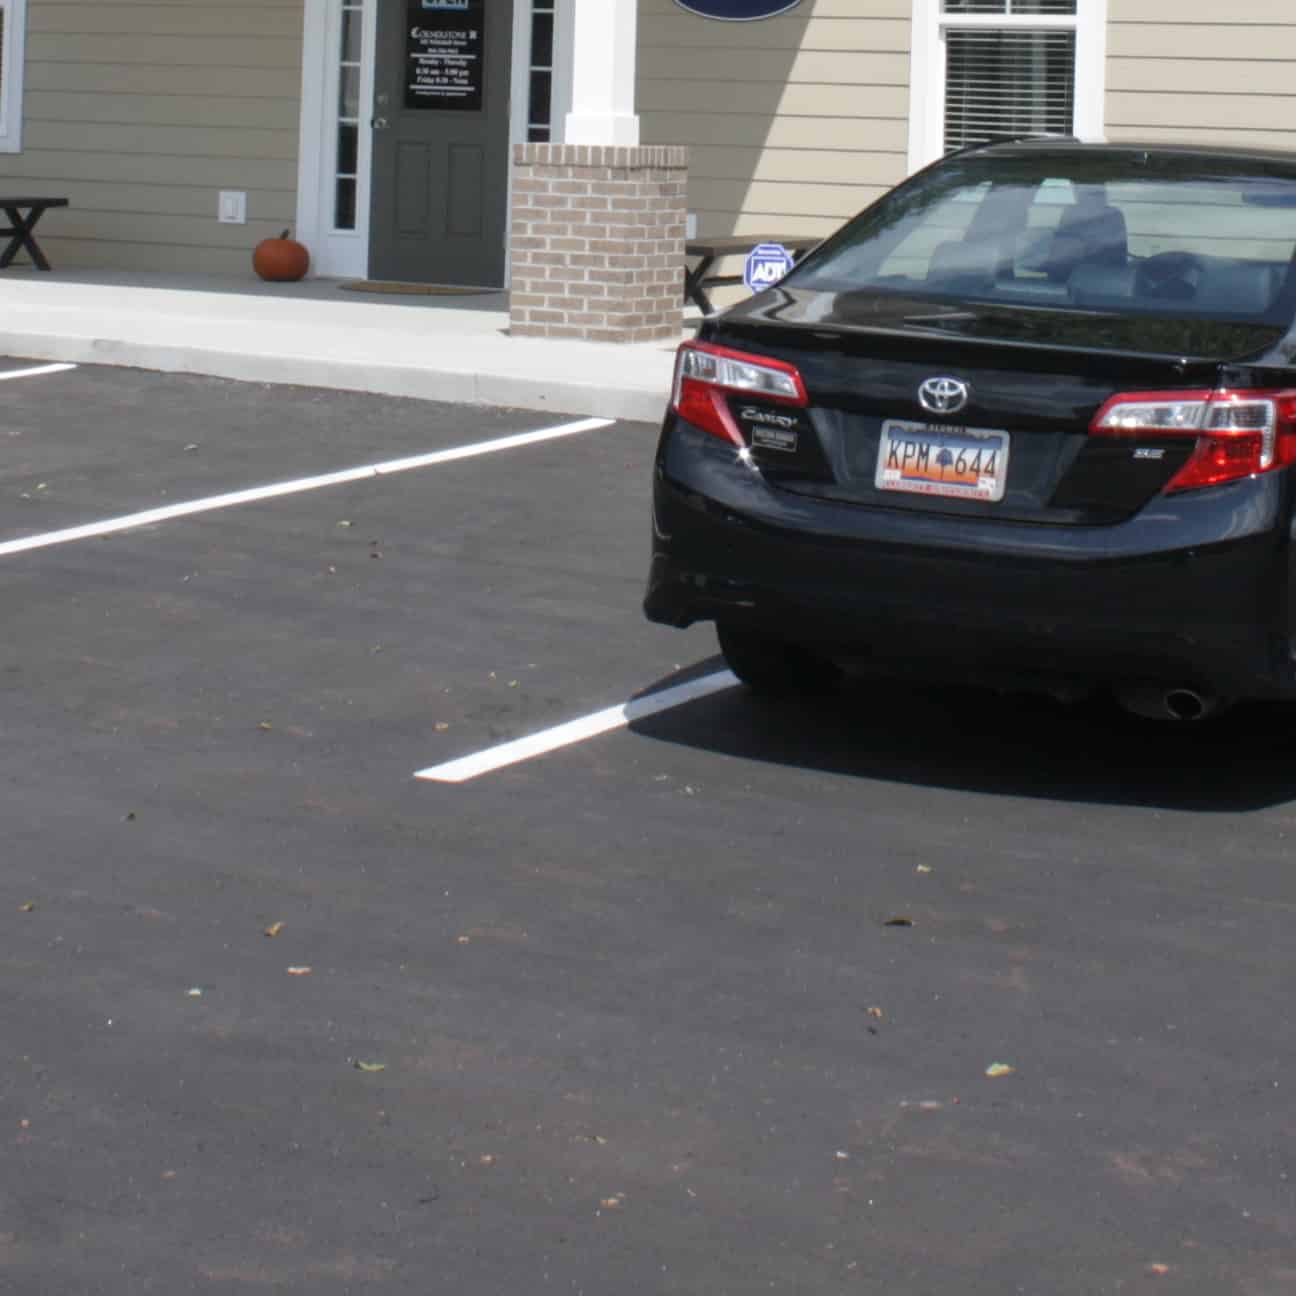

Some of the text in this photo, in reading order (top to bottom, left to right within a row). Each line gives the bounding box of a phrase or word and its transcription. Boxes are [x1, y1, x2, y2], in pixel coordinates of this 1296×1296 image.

[752, 261, 785, 281] ADT
[888, 439, 998, 476] KPM 644
